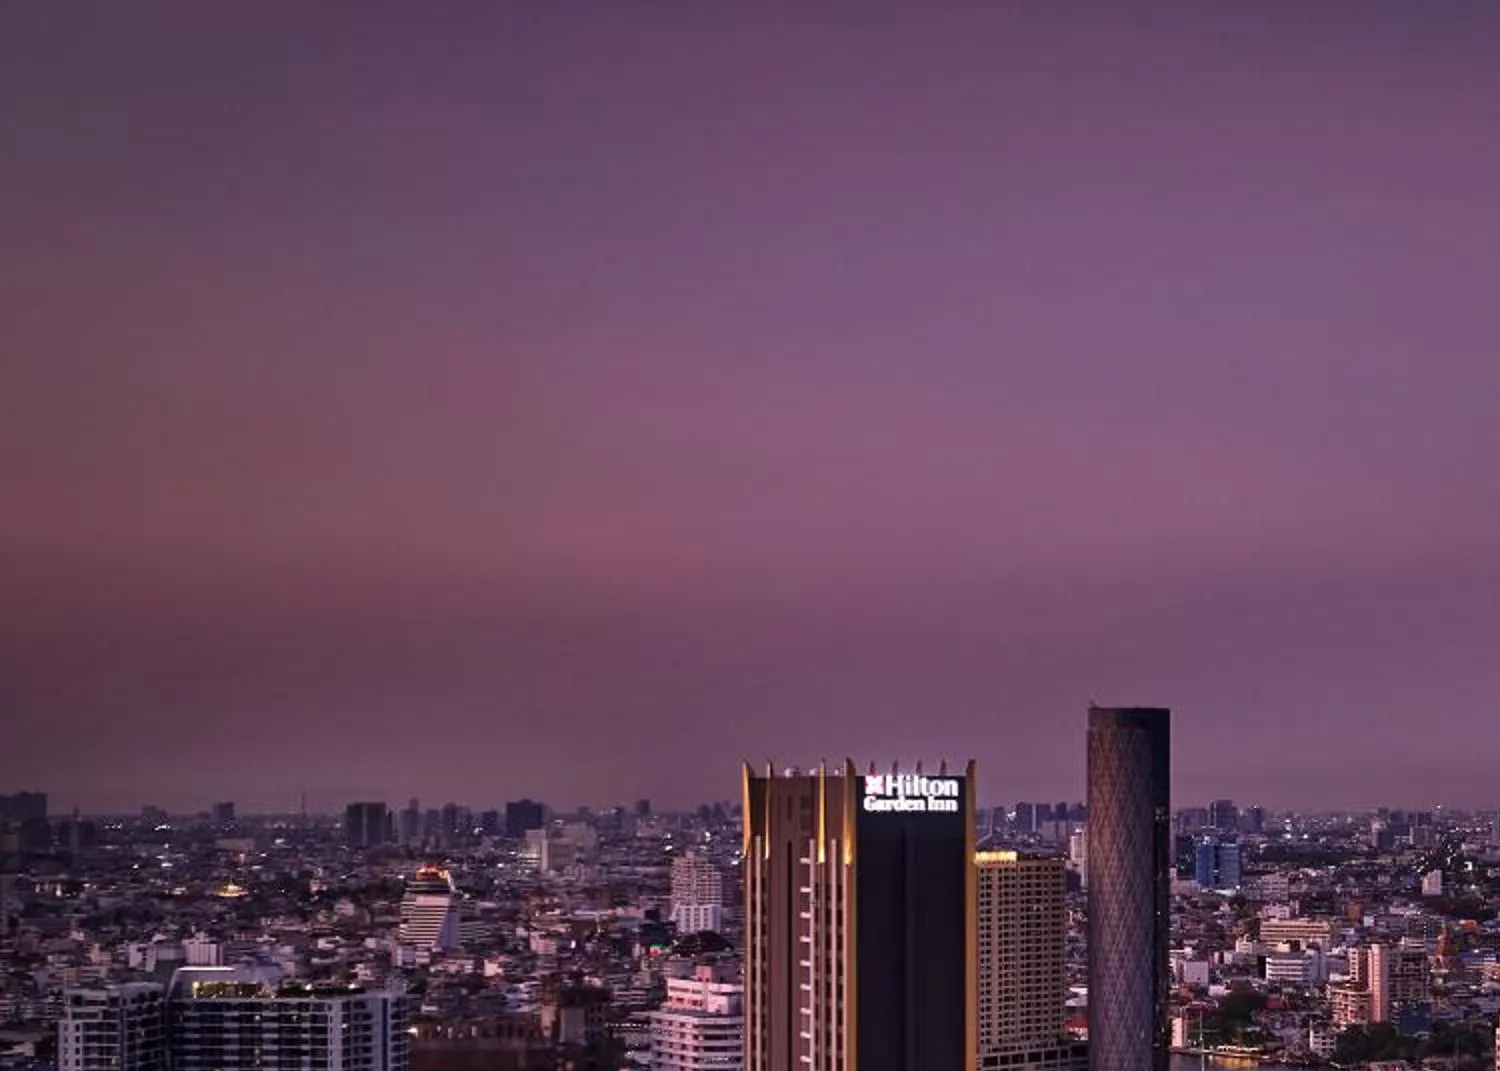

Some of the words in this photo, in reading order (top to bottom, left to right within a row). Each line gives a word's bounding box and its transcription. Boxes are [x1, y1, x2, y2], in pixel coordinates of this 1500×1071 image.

[885, 774, 959, 796] Hilton
[863, 795, 927, 812] Garden
[927, 797, 959, 812] Inn
